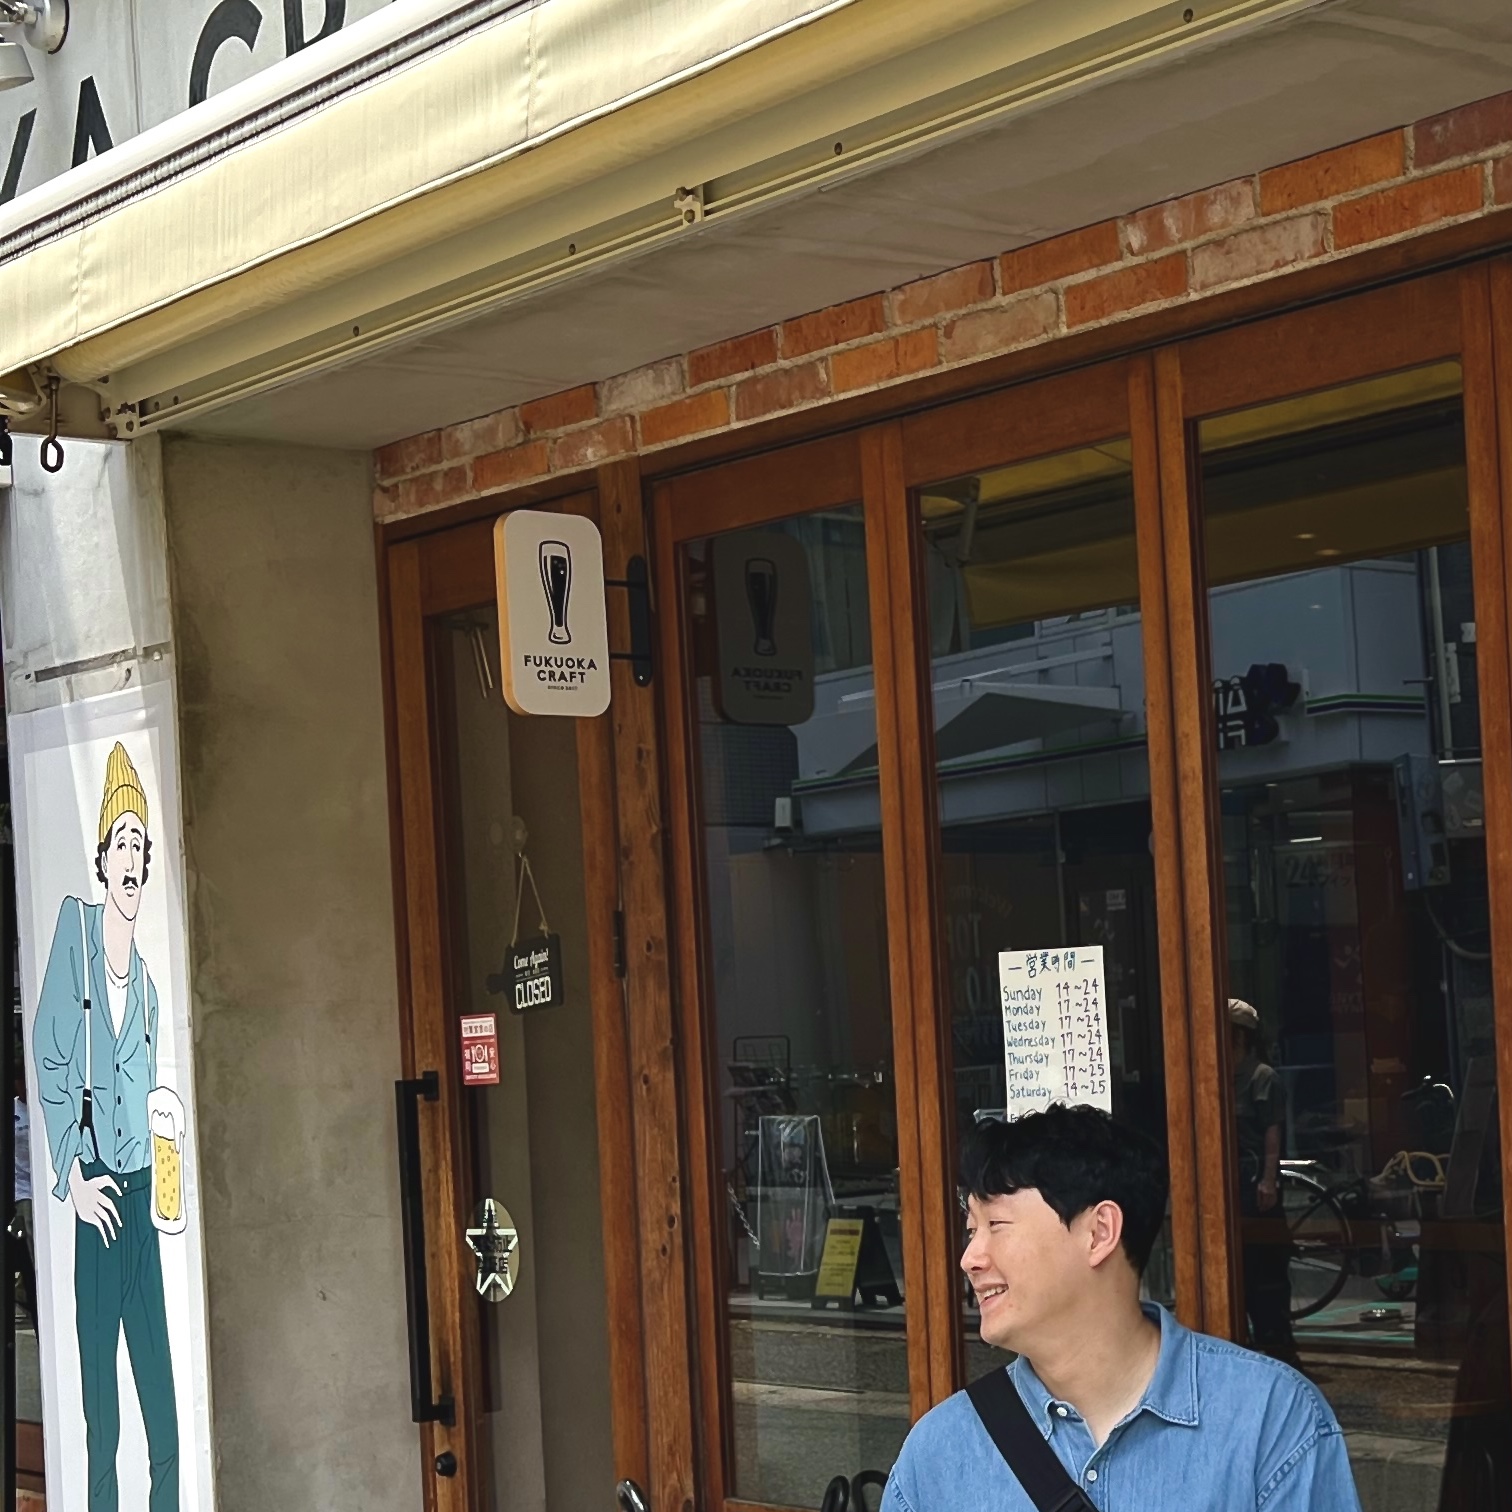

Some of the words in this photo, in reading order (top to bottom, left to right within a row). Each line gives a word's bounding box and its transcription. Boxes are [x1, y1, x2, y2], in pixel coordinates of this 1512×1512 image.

[523, 654, 598, 671] FUKUOKA
[536, 669, 586, 684] CRAFT
[515, 975, 552, 1010] CLOSED
[1003, 985, 1042, 1002] Sunday
[1004, 1003, 1041, 1017] Monday
[1005, 1019, 1047, 1033] Tuesday
[1006, 1035, 1055, 1049] Wednesday
[1008, 1051, 1050, 1067] Thursday
[1008, 1068, 1040, 1082] Friday
[1010, 1083, 1052, 1100] Saturday
